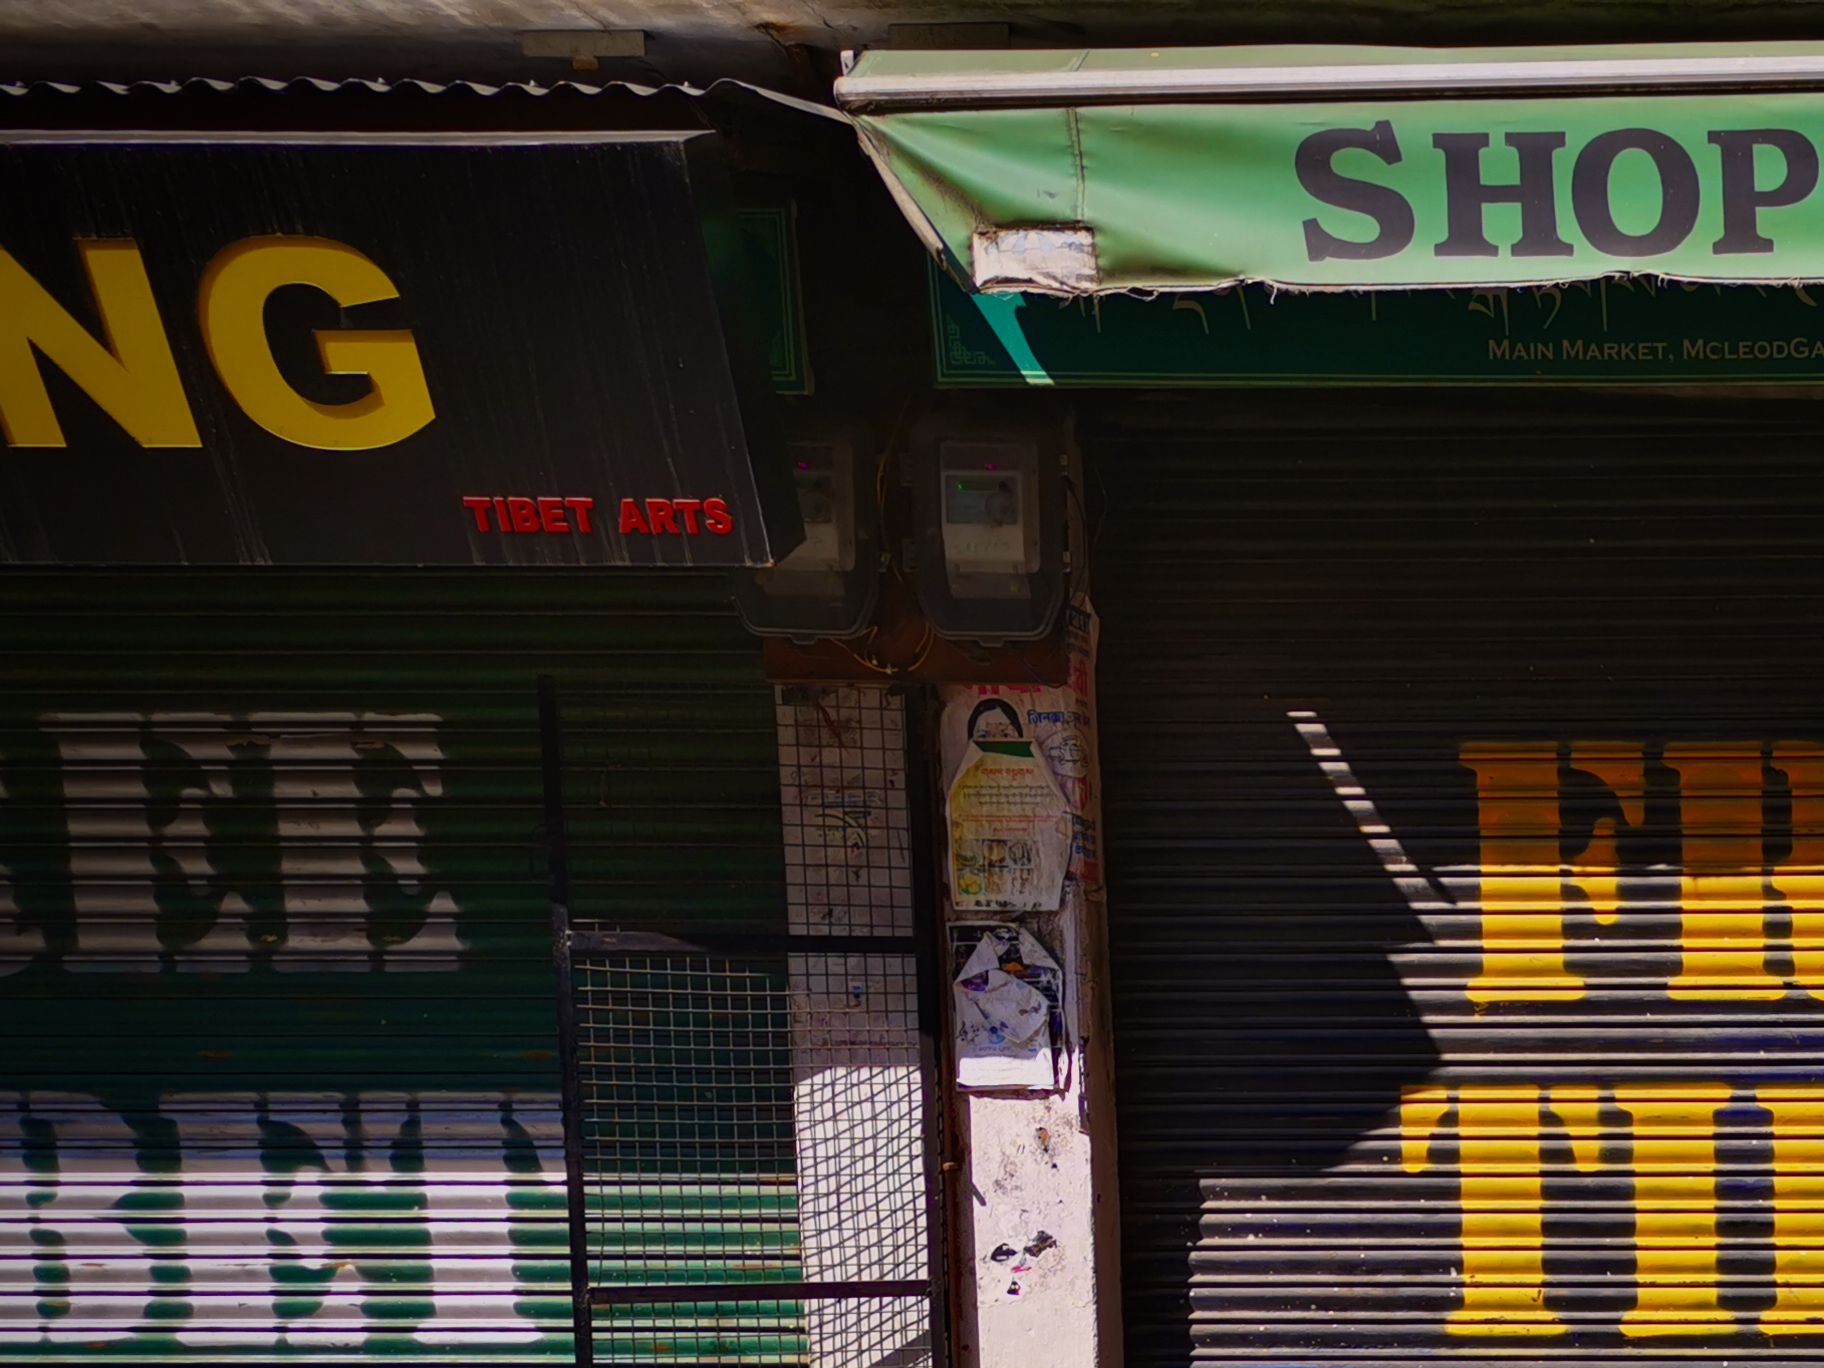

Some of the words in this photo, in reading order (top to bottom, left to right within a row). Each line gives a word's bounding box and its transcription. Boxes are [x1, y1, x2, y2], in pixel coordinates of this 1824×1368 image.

[1293, 118, 1820, 262] SHOP
[0, 233, 437, 451] NG
[1488, 338, 1554, 361] MAIN
[462, 496, 594, 533] TIBET
[619, 497, 733, 534] ARTS
[0, 711, 466, 976] EE
